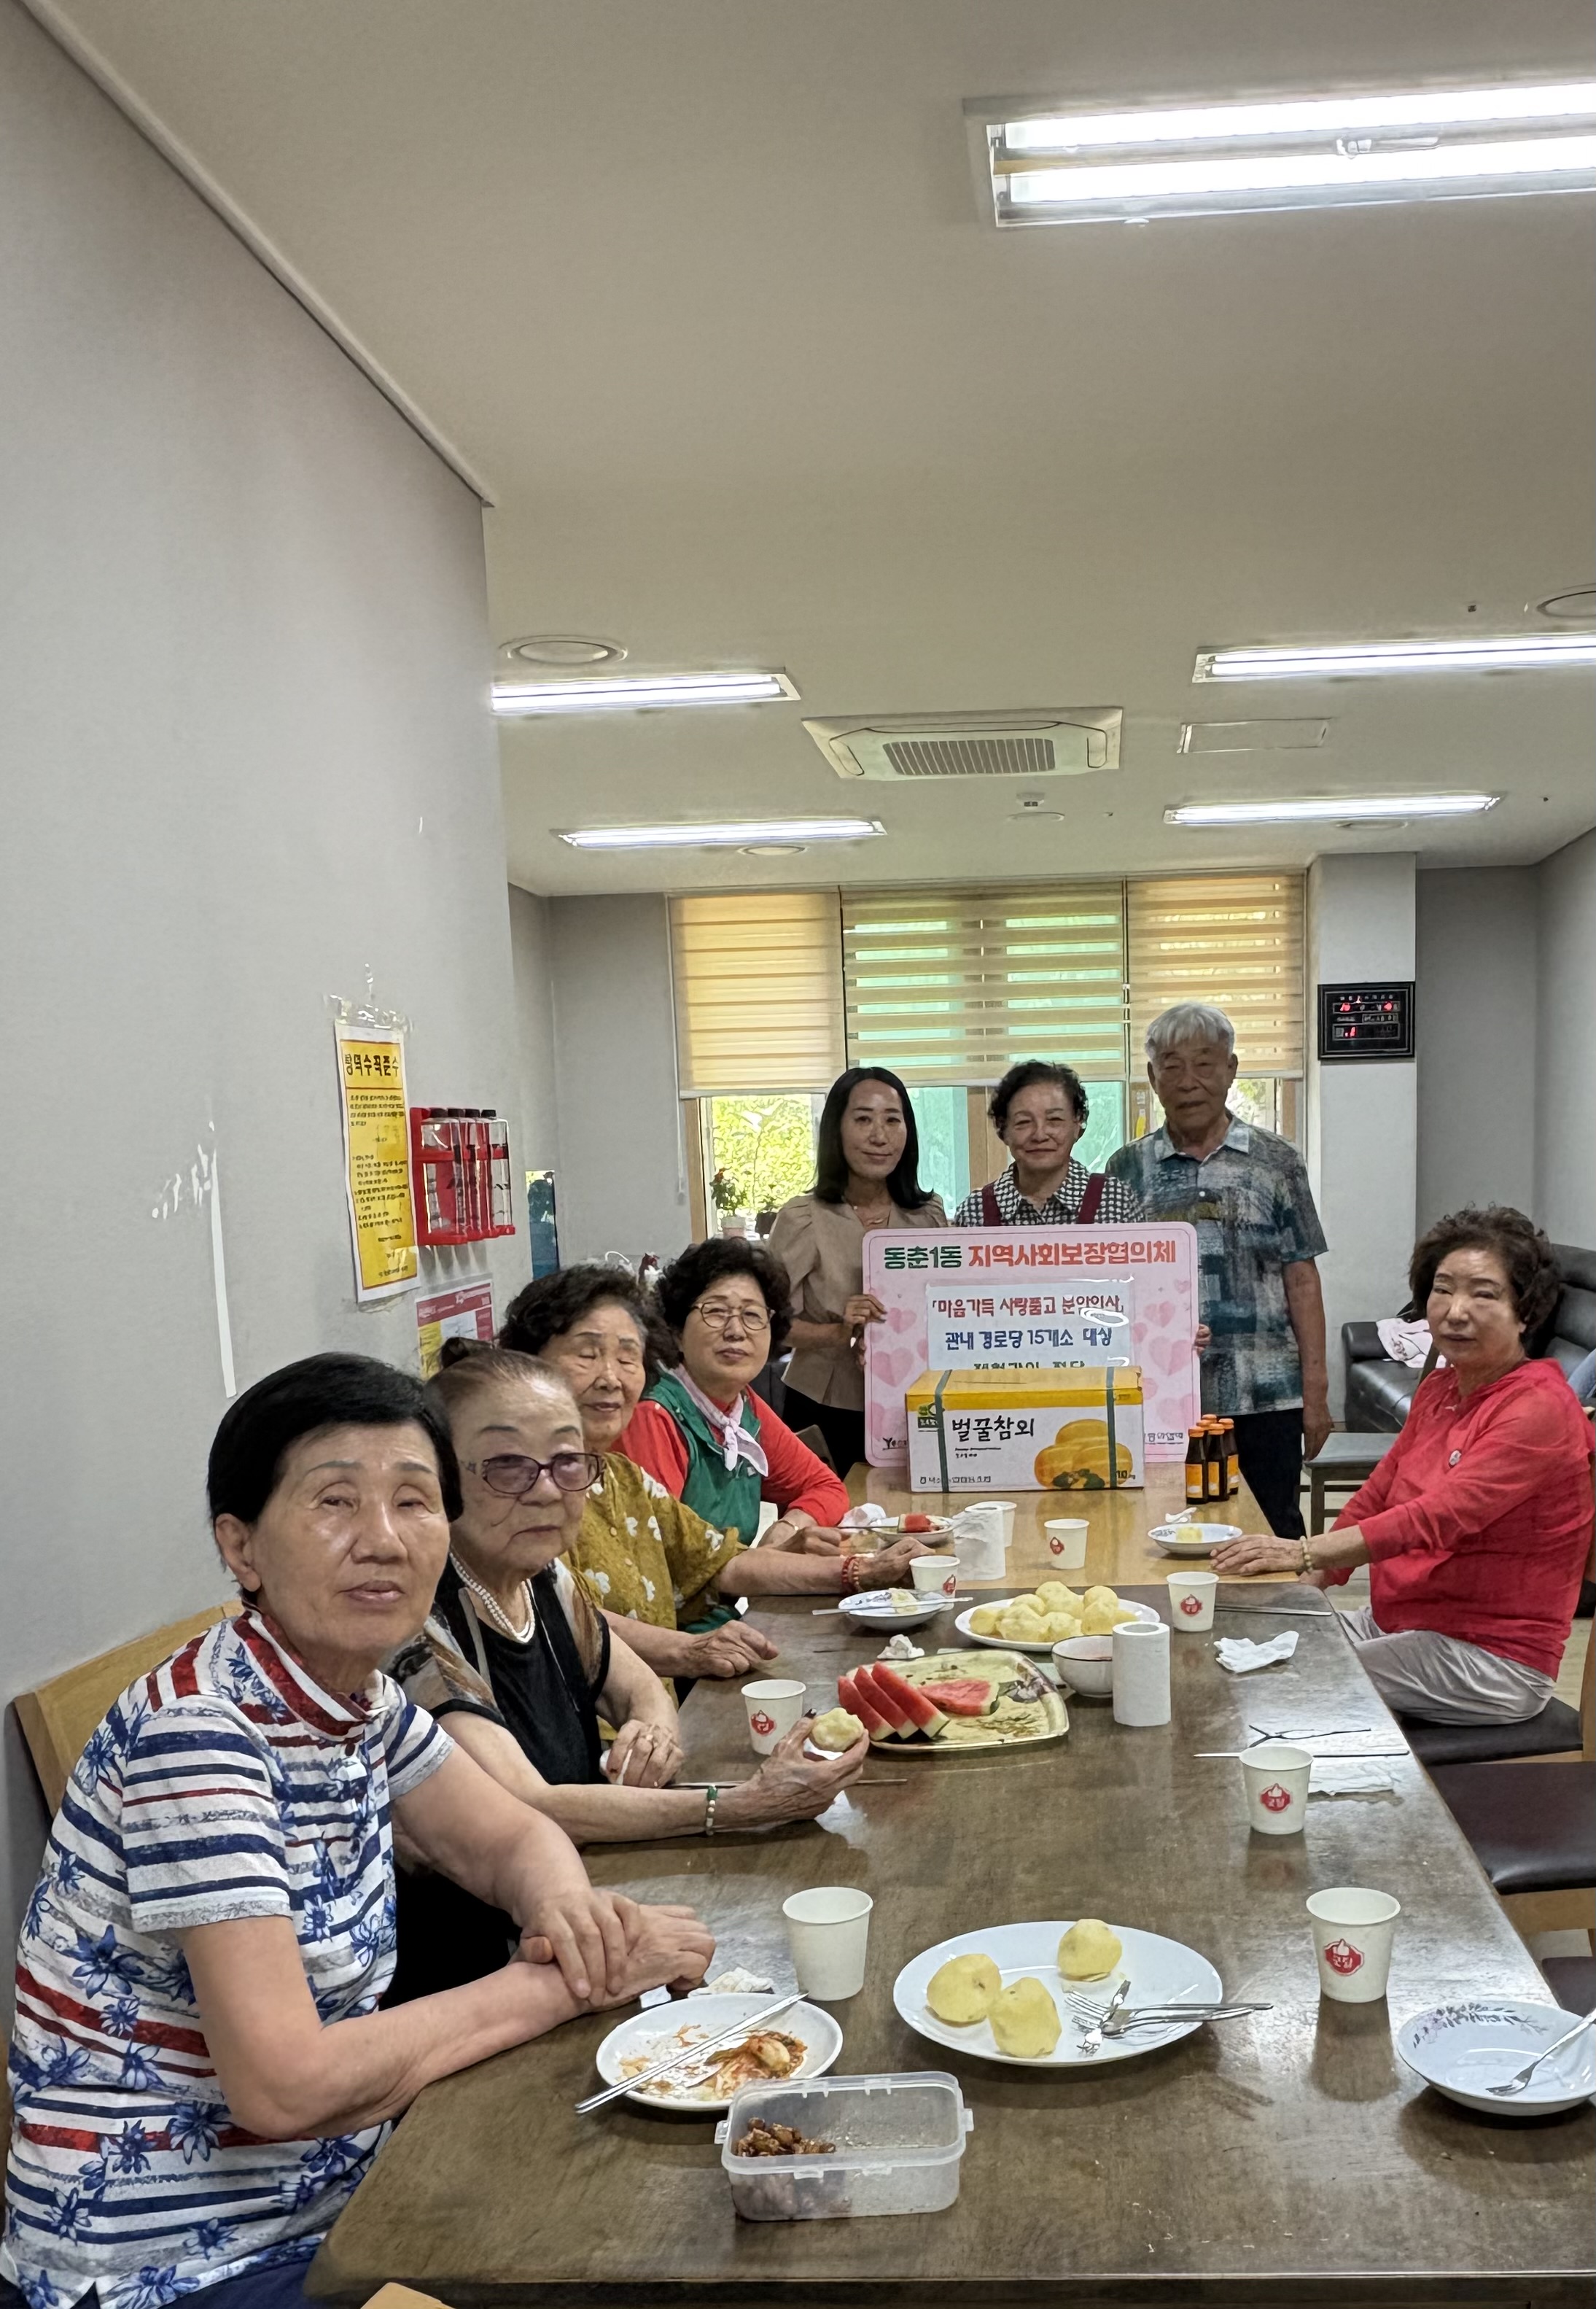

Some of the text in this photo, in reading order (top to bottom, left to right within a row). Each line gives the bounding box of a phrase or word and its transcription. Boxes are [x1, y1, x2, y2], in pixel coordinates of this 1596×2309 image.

[884, 1241, 1176, 1268] 동춘1동 지역사회보장협의체
[1000, 1297, 1056, 1316] 사랑품고
[945, 1327, 1112, 1350] 관내 경로당 15개소 대상
[951, 1415, 1035, 1442] 벌꿀참외
